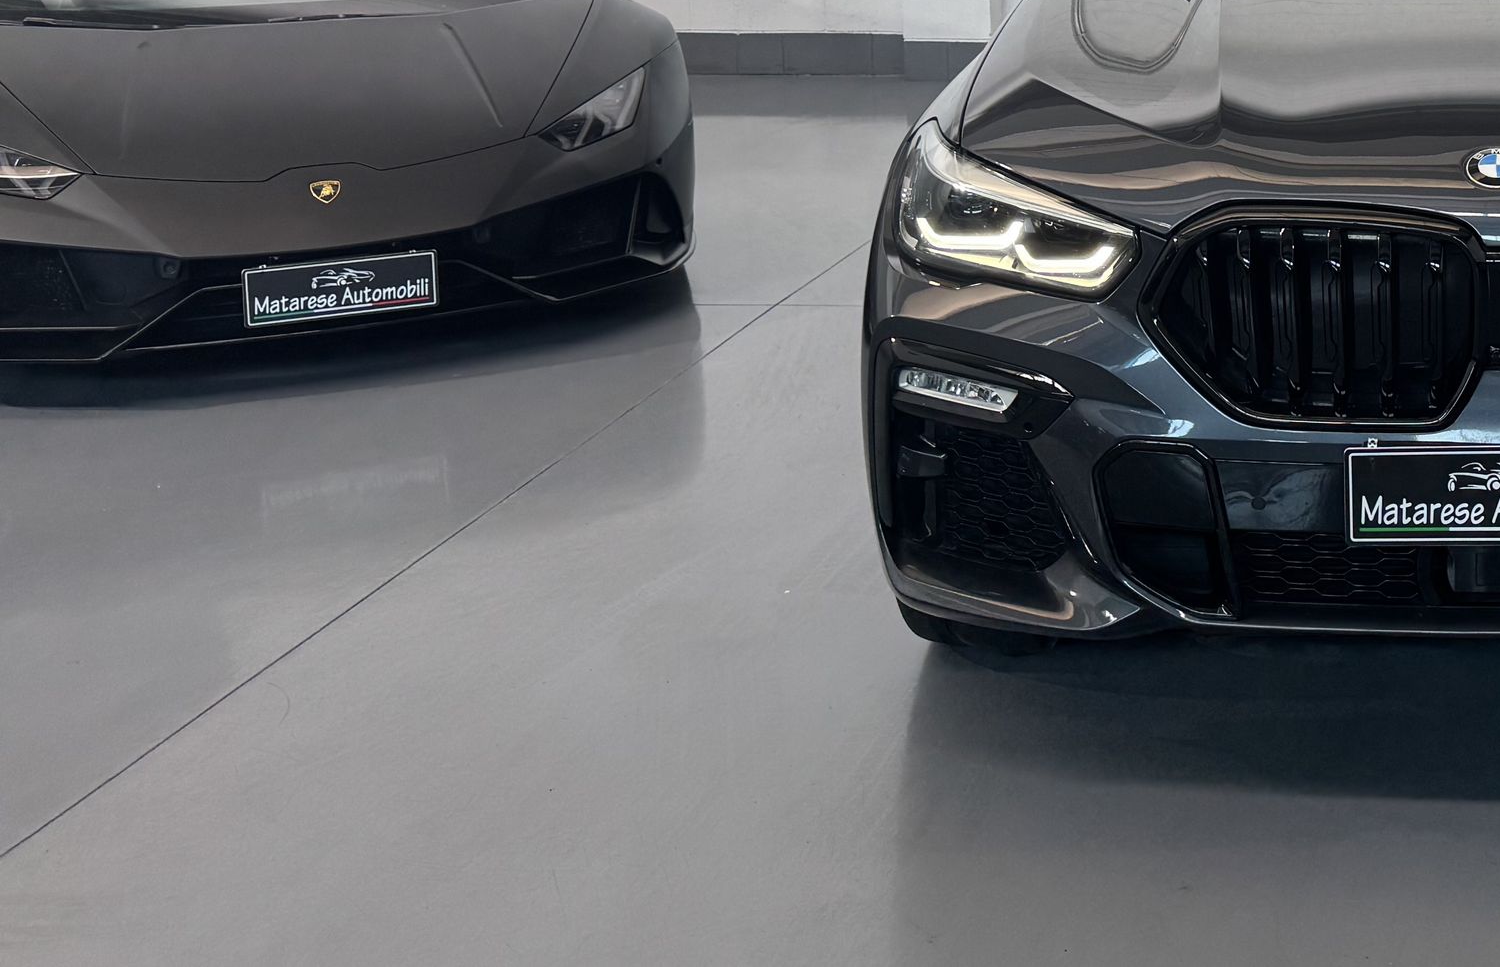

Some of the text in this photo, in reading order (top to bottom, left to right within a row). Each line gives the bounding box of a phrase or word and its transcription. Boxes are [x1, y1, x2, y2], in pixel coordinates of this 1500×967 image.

[254, 278, 429, 315] Matarese Automobili
[1360, 495, 1485, 525] Matarese
